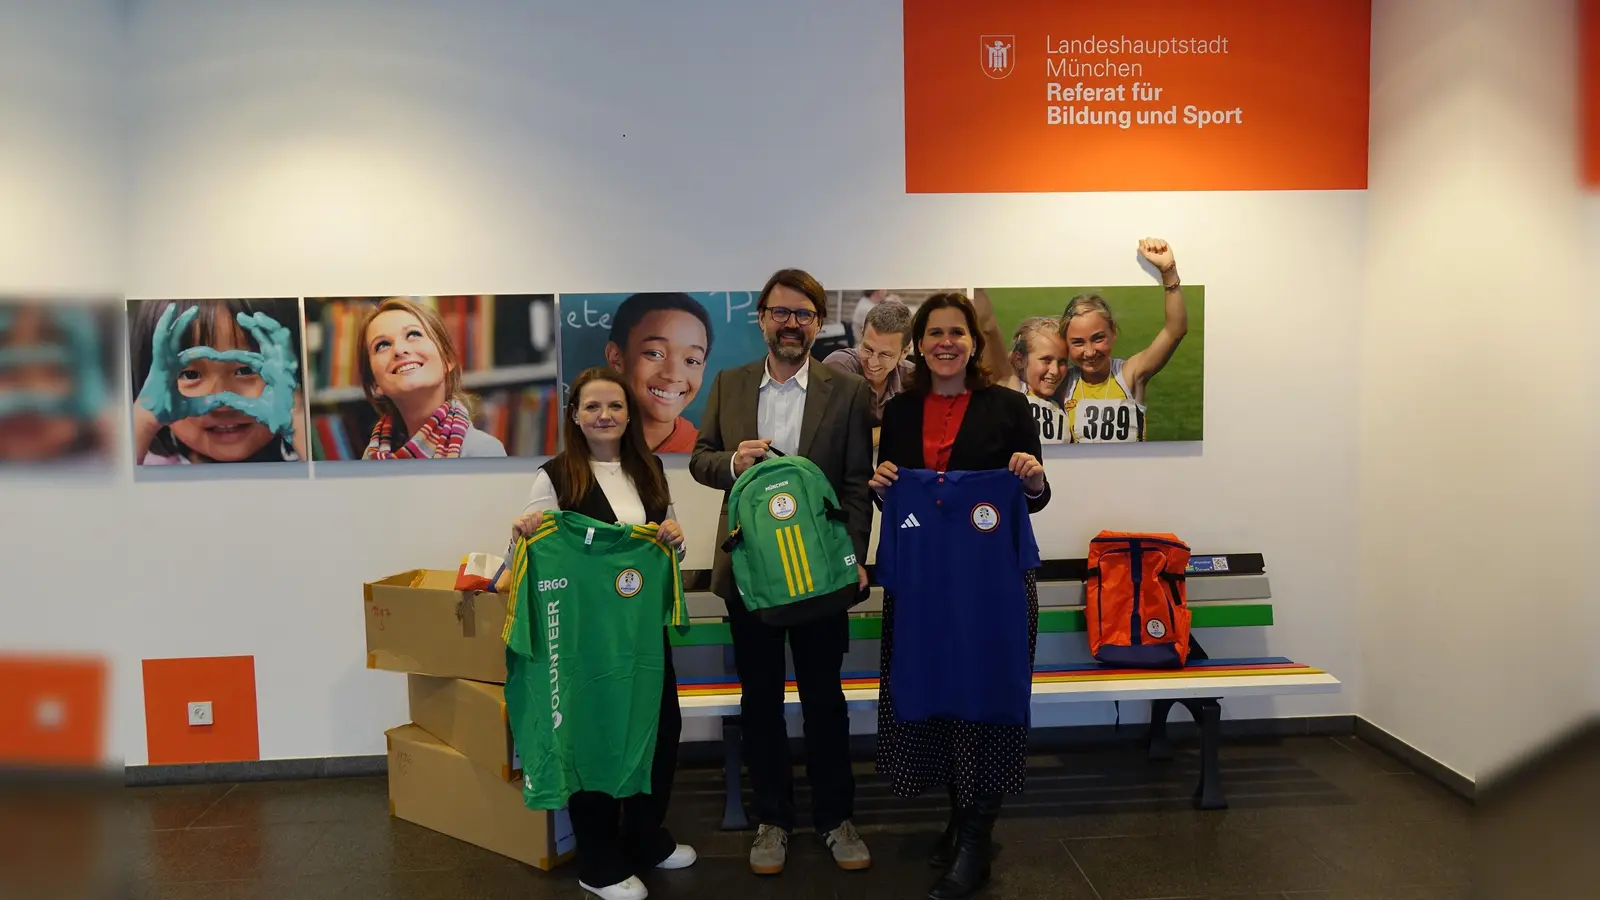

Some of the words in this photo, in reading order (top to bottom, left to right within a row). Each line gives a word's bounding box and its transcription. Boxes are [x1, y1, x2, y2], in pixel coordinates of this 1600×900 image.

[1047, 35, 1229, 57] Landeshauptstadt
[1047, 58, 1143, 77] München
[1047, 83, 1126, 102] Referat
[1132, 82, 1163, 102] für
[1047, 106, 1132, 128] Bildung
[1137, 106, 1177, 125] und
[1183, 105, 1243, 128] Sport
[1083, 405, 1130, 441] 389
[764, 480, 789, 492] MÜNCHEN
[537, 577, 568, 592] ERGO
